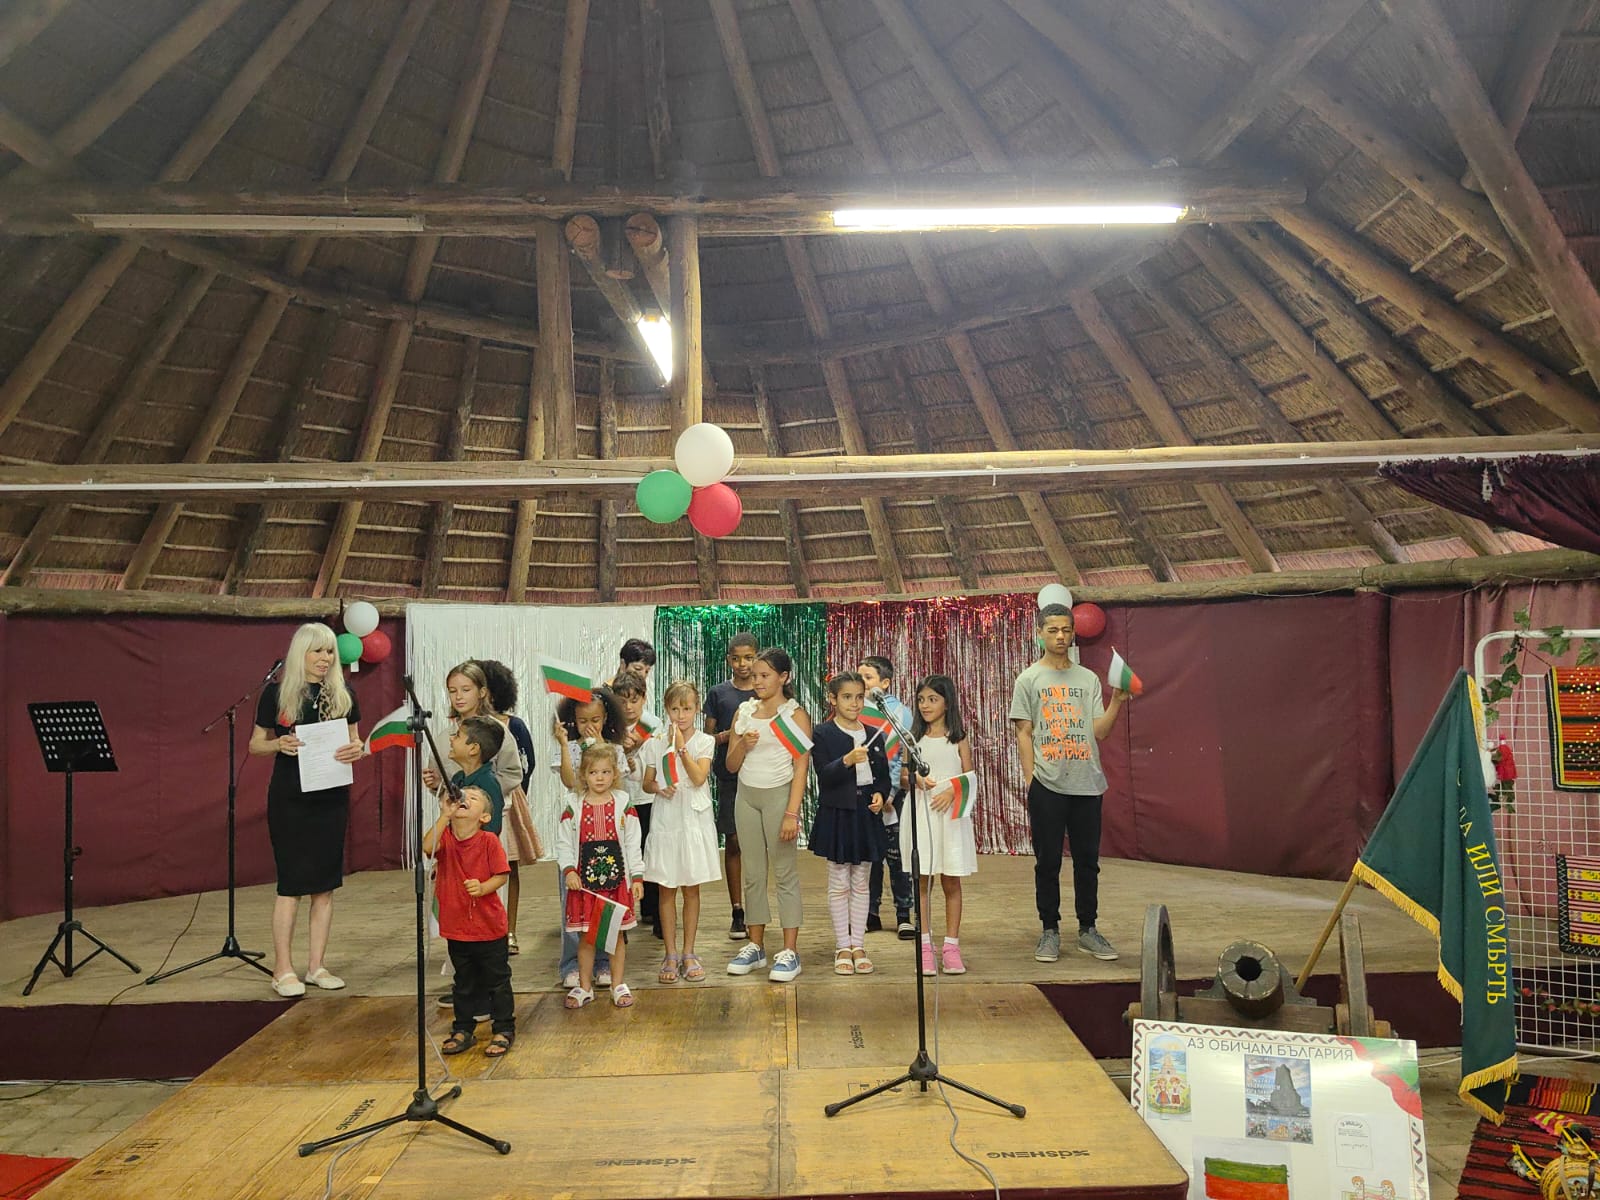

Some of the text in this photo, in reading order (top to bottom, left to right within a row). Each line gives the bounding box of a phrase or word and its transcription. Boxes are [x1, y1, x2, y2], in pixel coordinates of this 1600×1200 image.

[1041, 687, 1066, 698] DONT
[1068, 687, 1085, 699] GET
[1465, 841, 1503, 899] ИЛИ
[1485, 905, 1507, 1005] СМЪРТЬ
[1187, 1037, 1353, 1061] АЗ ОБИЧАМ БЪЛГАРИЯ
